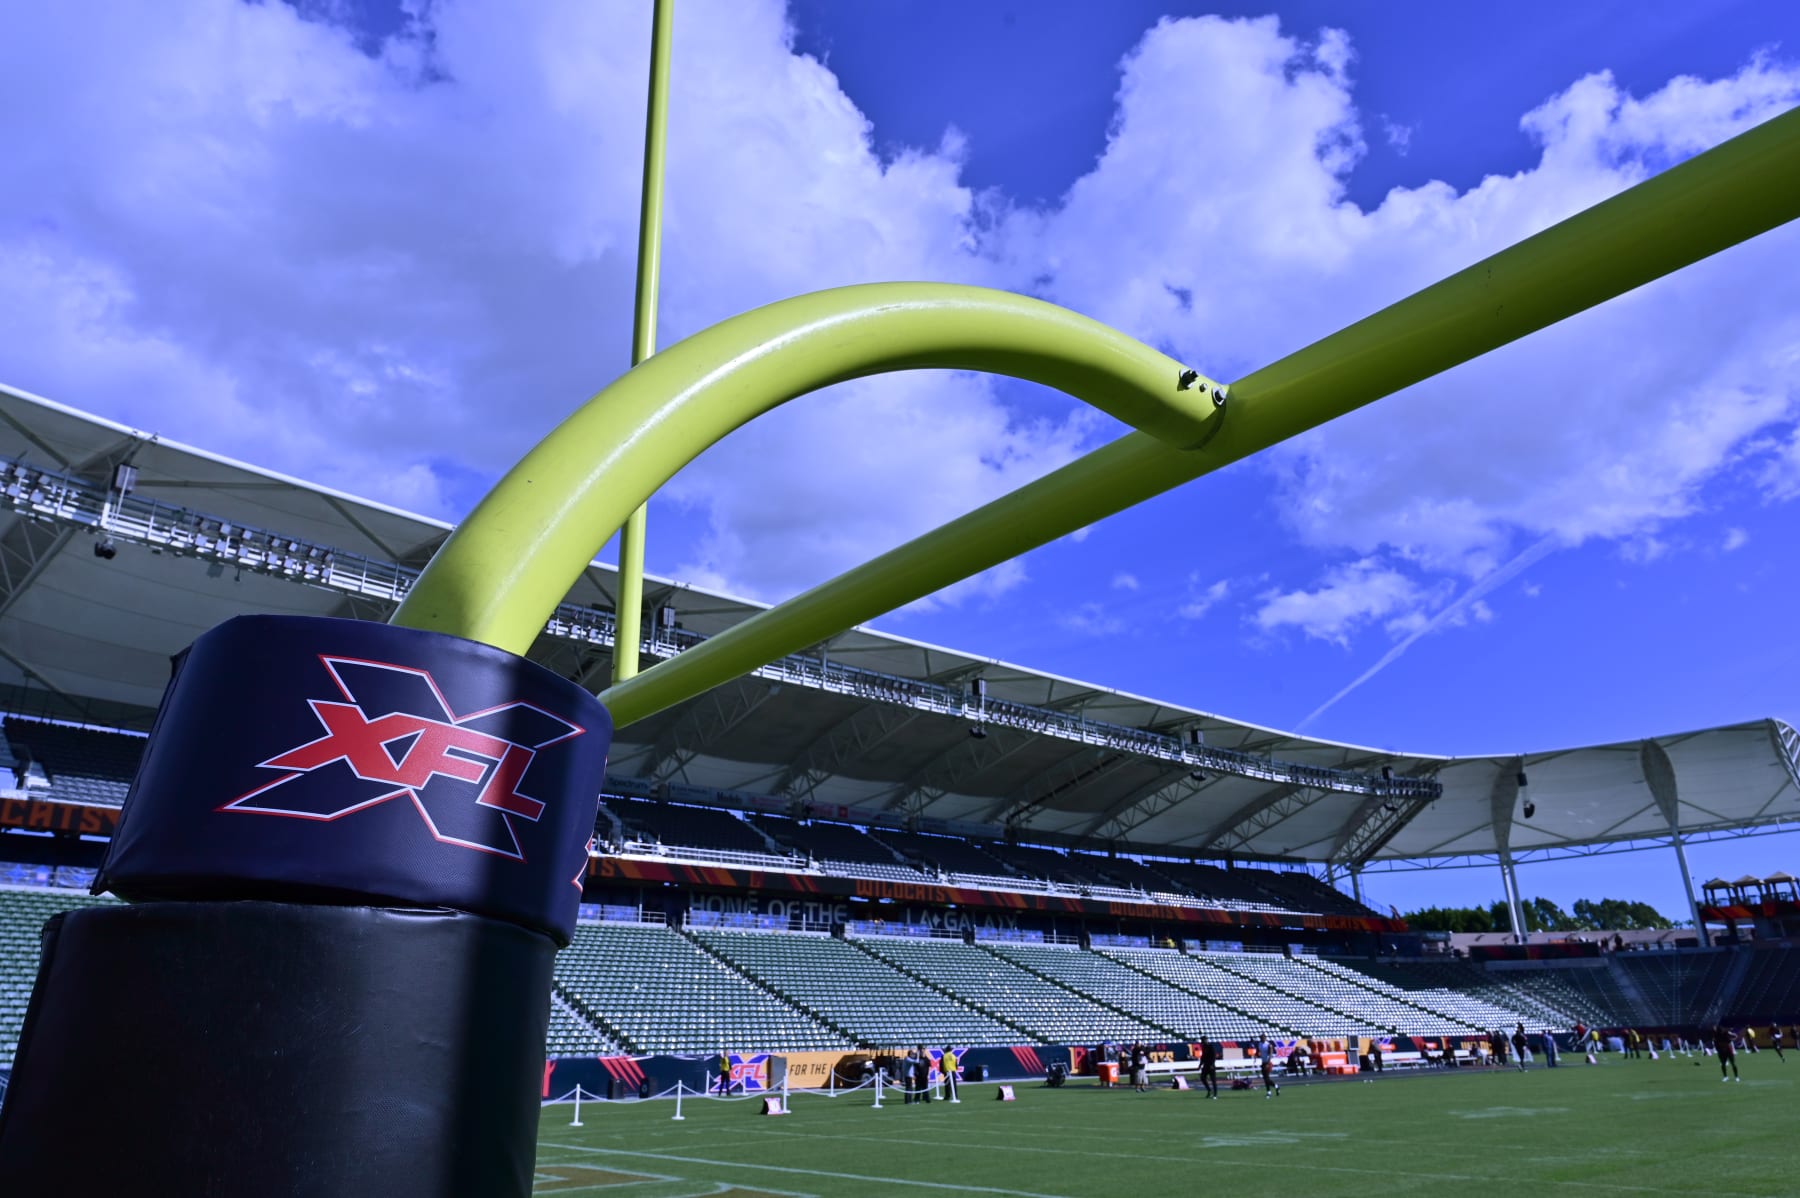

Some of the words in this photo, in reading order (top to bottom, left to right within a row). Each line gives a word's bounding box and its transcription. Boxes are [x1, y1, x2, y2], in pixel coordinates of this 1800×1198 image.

[254, 699, 547, 822] XFL
[855, 880, 945, 901] WILDCATS
[767, 899, 800, 919] OF
[804, 901, 848, 925] THE
[790, 1064, 808, 1076] FOR
[810, 1063, 827, 1075] THE
